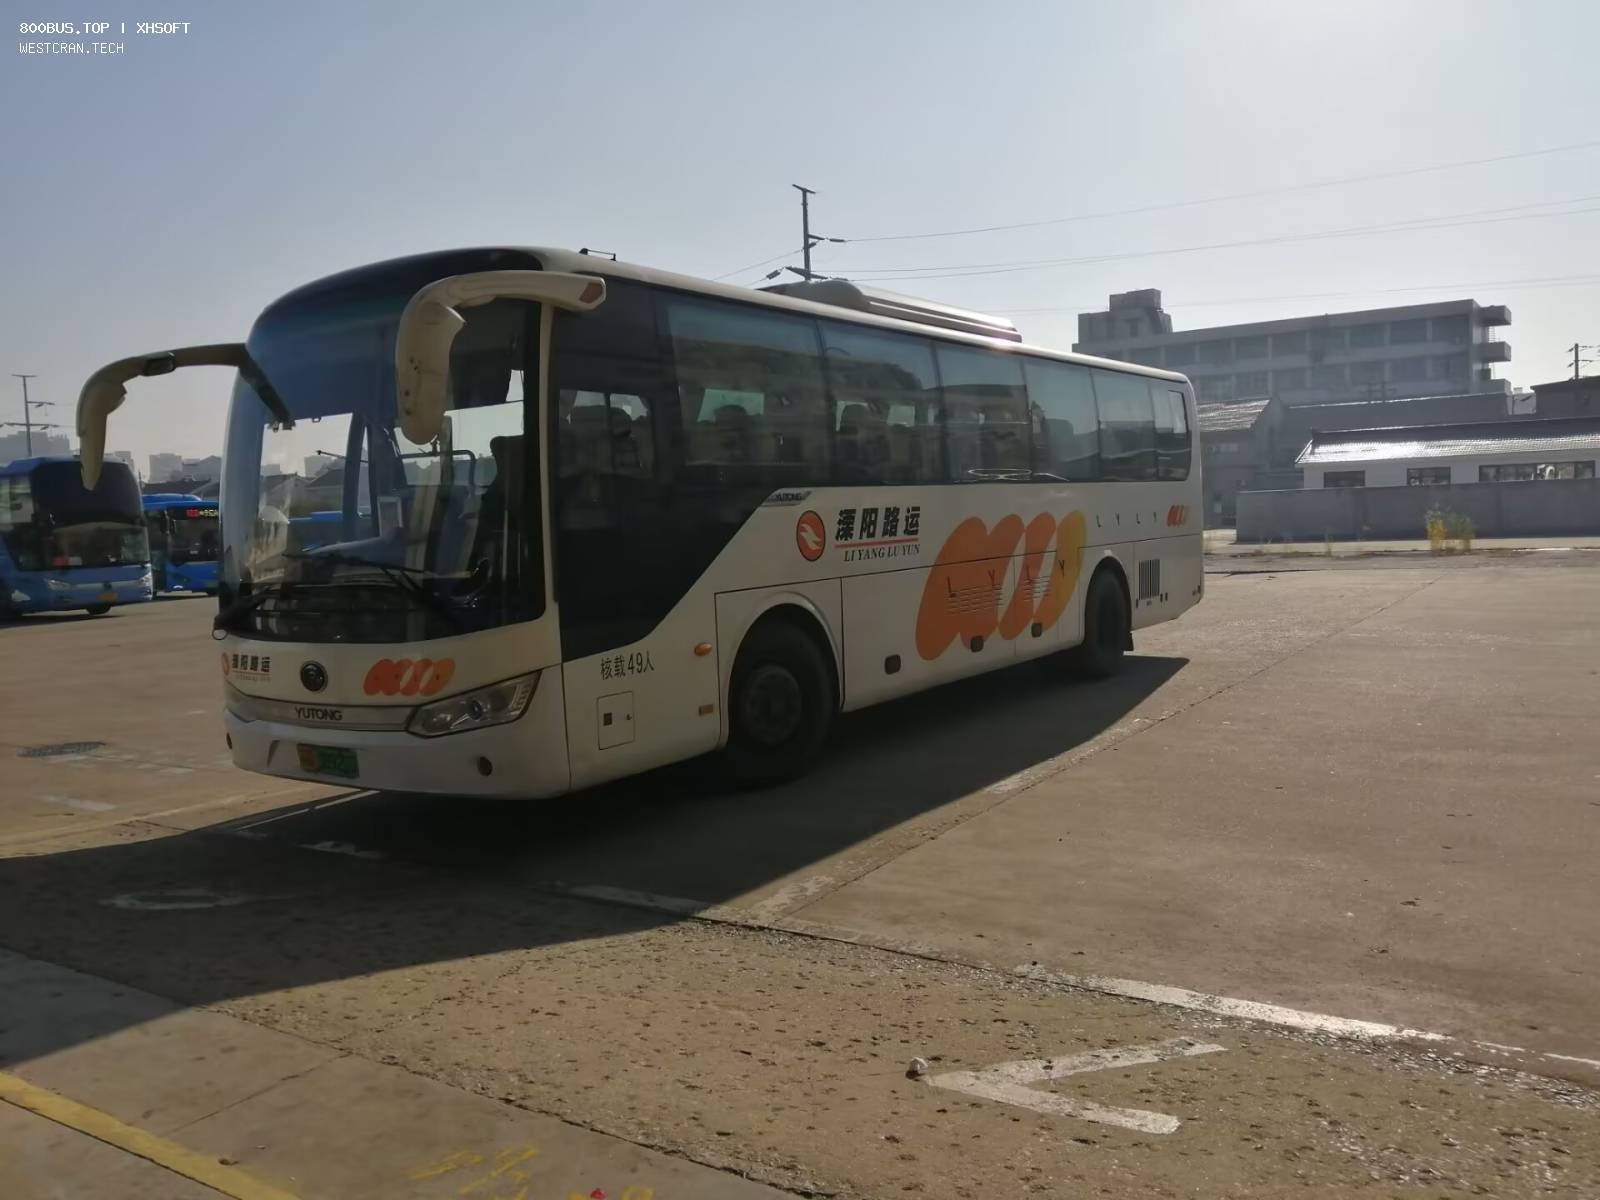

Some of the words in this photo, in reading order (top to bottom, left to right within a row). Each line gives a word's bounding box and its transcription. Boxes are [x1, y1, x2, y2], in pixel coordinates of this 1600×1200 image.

[835, 506, 921, 541] 溧阳路运
[295, 706, 343, 721] YUTONG
